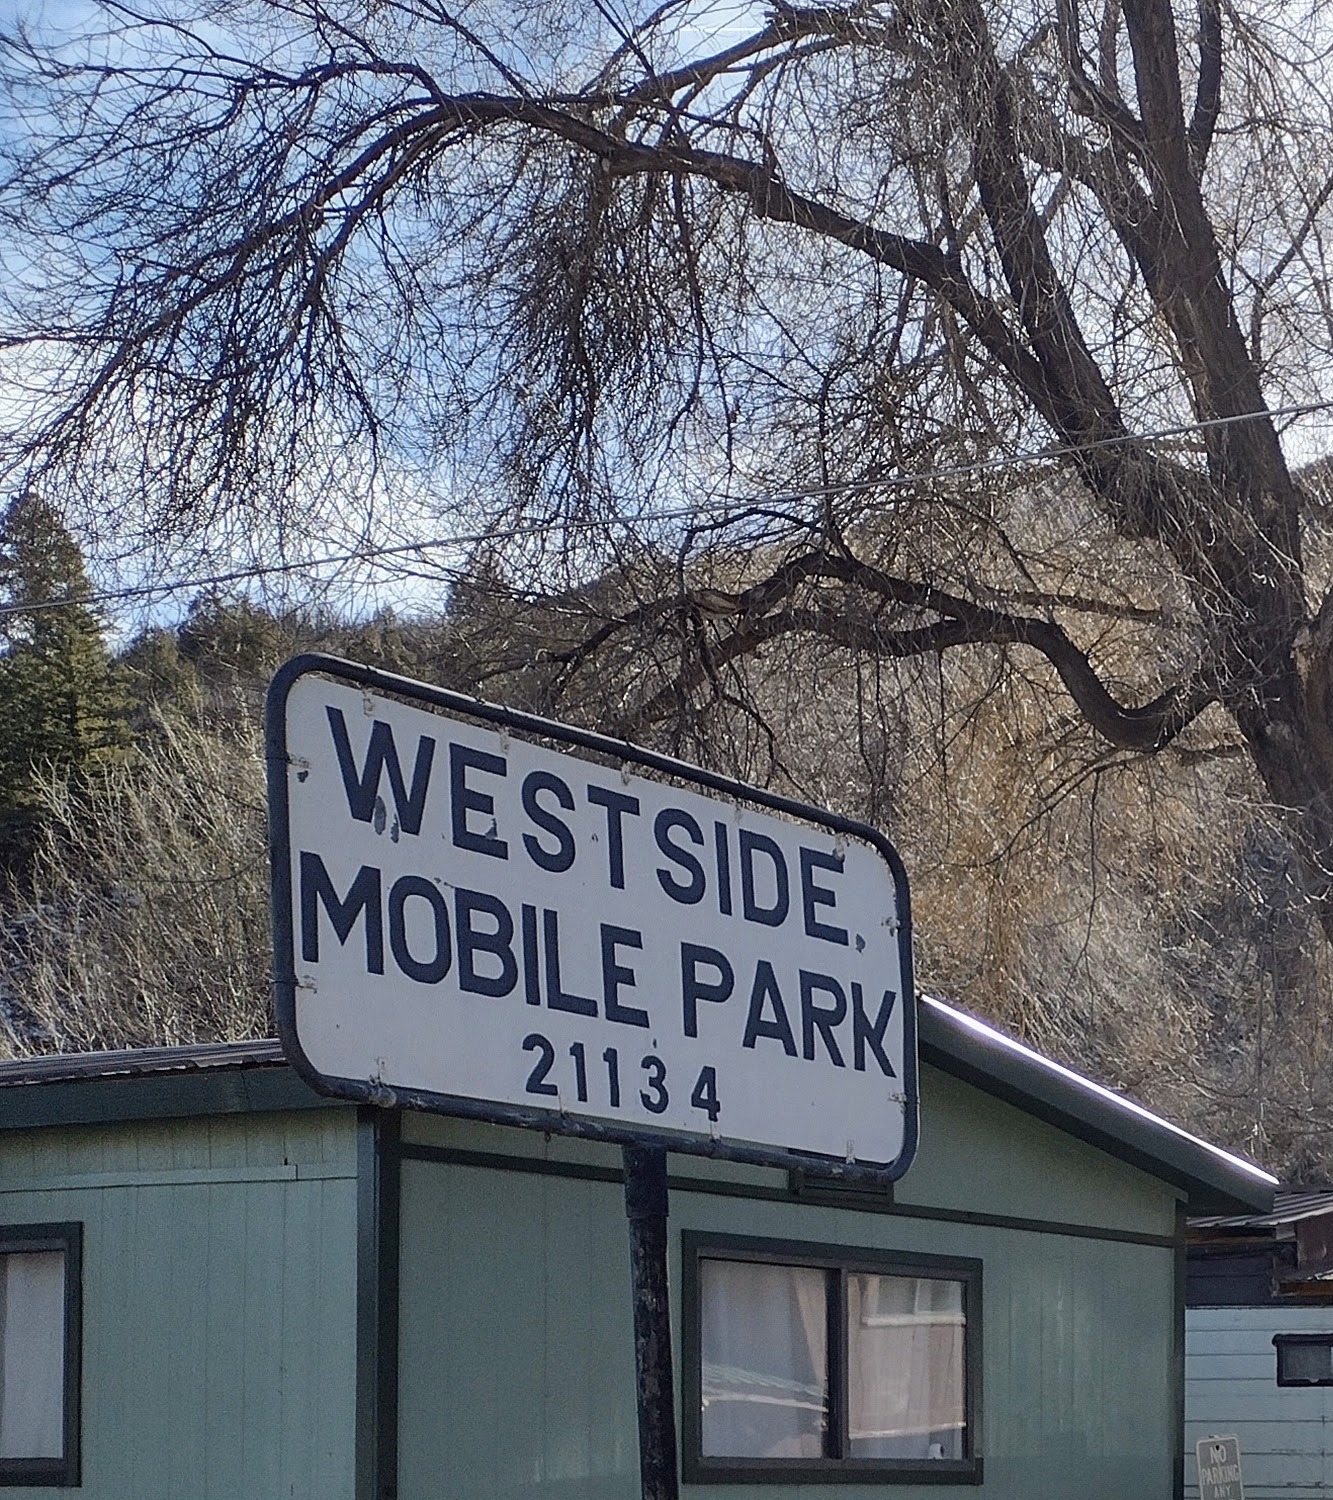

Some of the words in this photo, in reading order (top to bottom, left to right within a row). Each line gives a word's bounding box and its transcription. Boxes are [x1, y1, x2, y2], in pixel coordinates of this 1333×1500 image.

[325, 705, 849, 947] WESTSIDE
[299, 850, 650, 1029] MOBILE
[680, 941, 897, 1079] PARK
[521, 1032, 721, 1123] 21134
[1201, 1464, 1239, 1486] PARKING
[1210, 1445, 1226, 1463] NO
[1214, 1485, 1230, 1498] ANY
